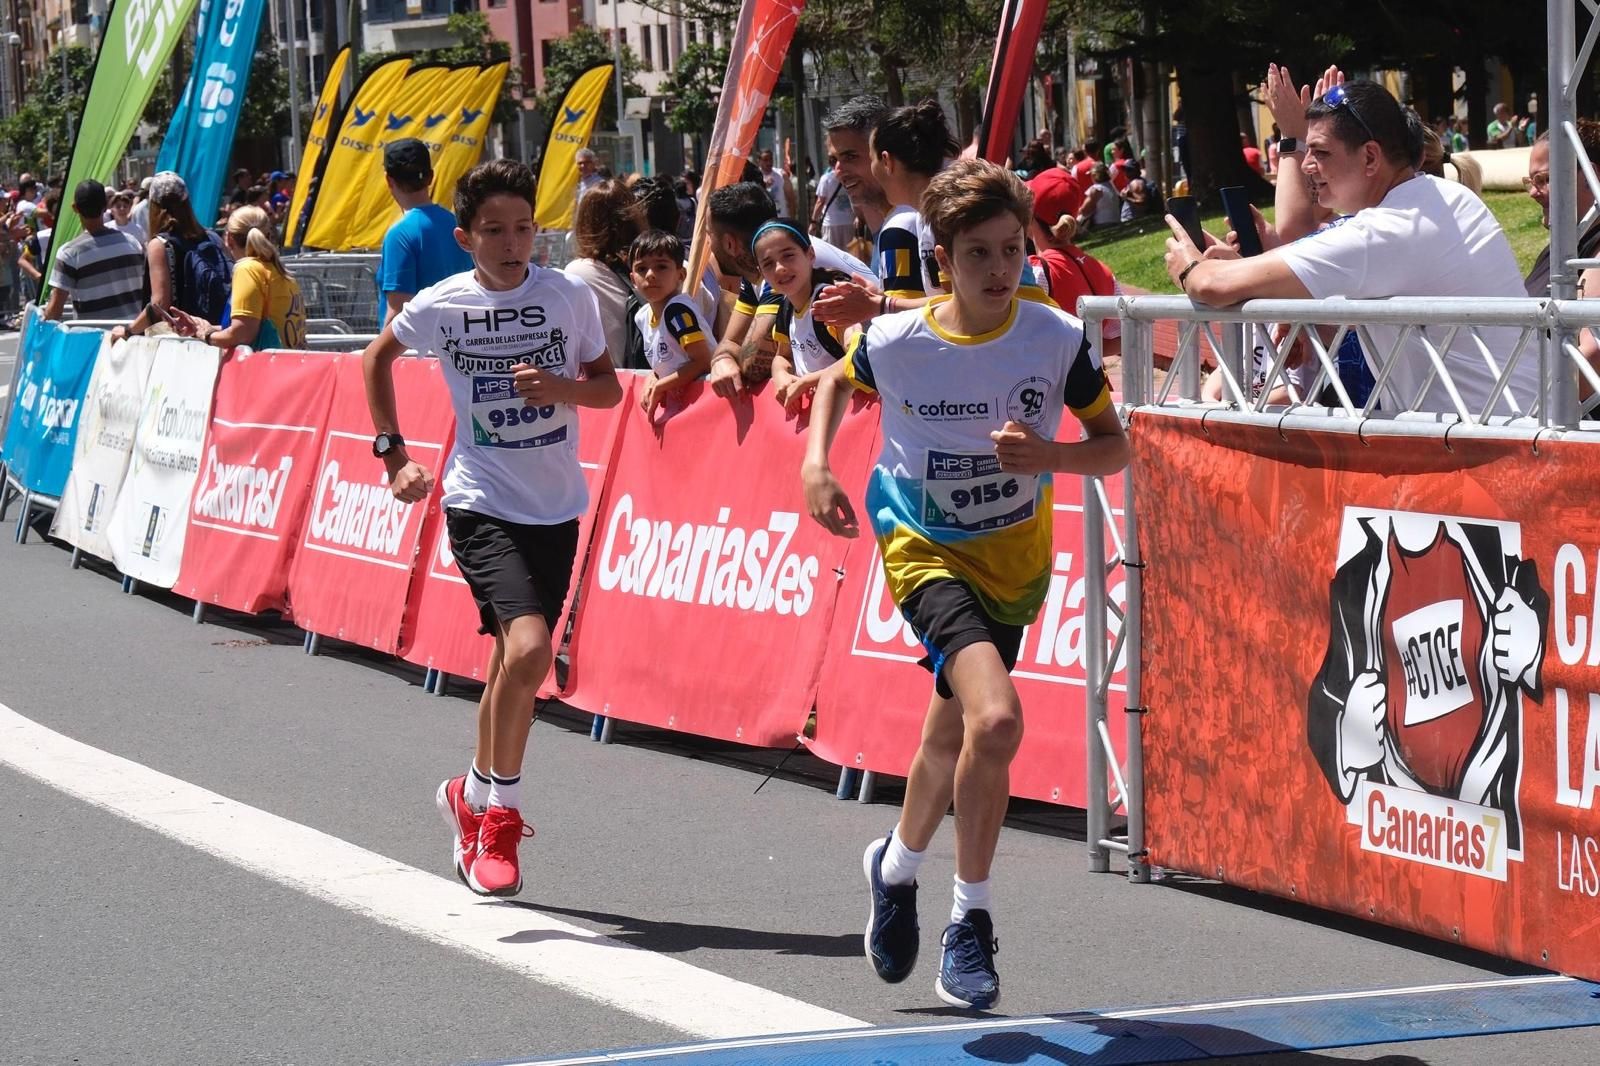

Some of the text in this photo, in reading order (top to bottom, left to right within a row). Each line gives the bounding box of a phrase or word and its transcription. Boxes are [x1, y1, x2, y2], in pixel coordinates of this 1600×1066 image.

[463, 305, 547, 333] HPS
[465, 331, 549, 347] CARRERA DE LAS EMPRESAS
[476, 379, 511, 393] HPS
[918, 400, 989, 417] cofarca
[1019, 388, 1045, 412] 90
[932, 458, 974, 470] HPS
[951, 478, 1019, 509] 9156
[1402, 622, 1468, 699] #C7CE
[1367, 789, 1501, 873] Canarias7
